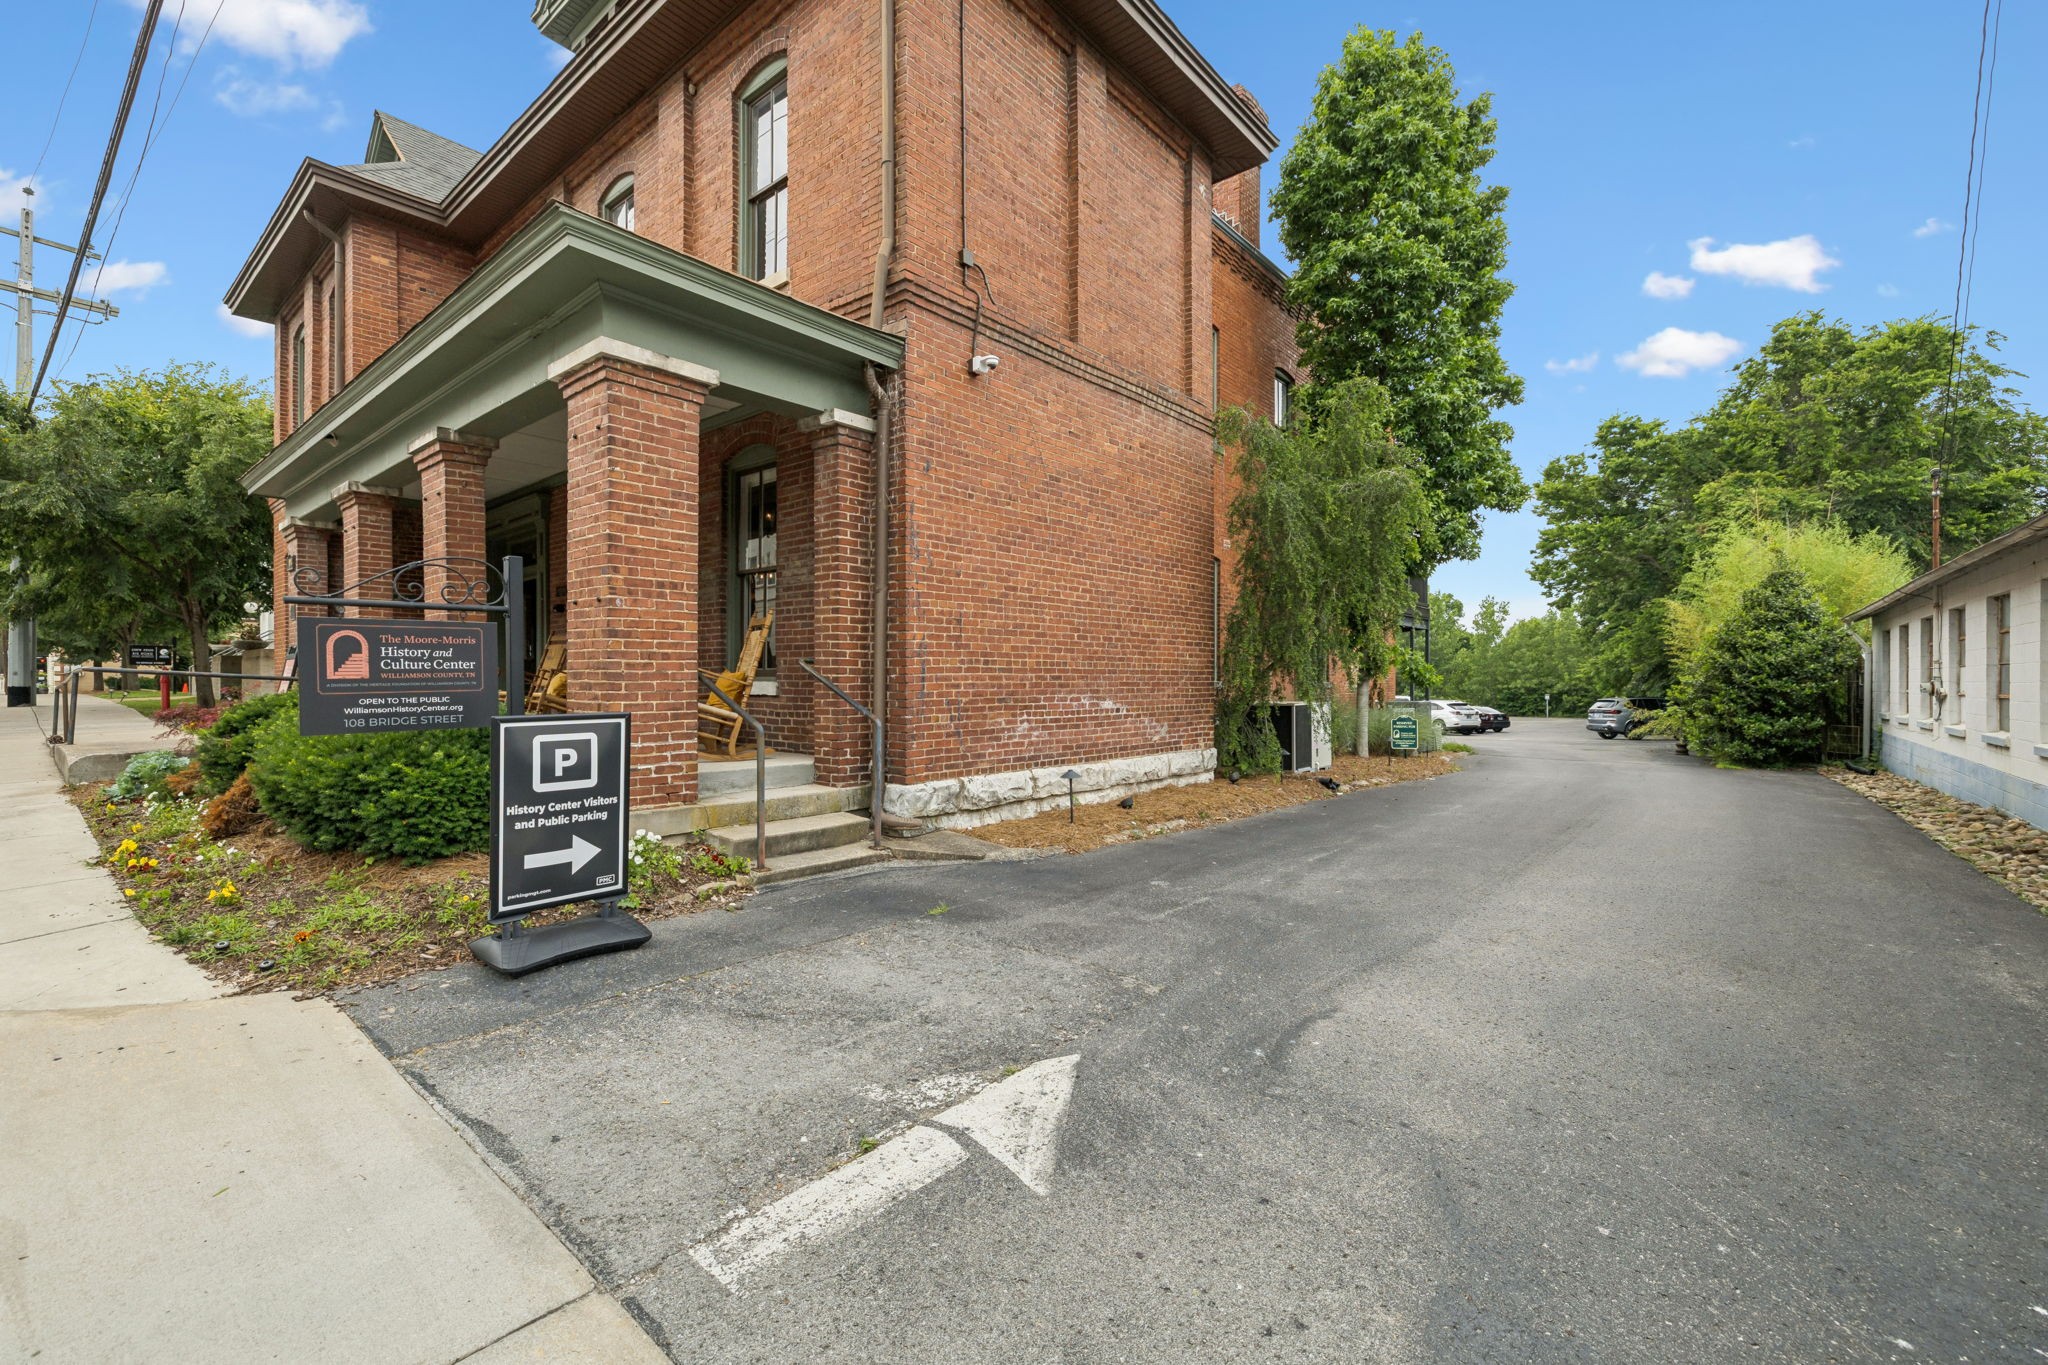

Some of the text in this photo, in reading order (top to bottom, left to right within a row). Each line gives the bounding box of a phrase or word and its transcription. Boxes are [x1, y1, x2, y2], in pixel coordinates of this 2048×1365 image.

[380, 634, 476, 645] The Moore-Morris
[380, 646, 453, 660] History and
[380, 658, 476, 670] Culture Center
[432, 671, 464, 679] COUNTY,
[343, 704, 464, 715] WilliamsonHistoryCenter.org
[343, 714, 464, 728] 108 BRIDGE STREET
[554, 747, 578, 777] P
[506, 796, 618, 816] History Center Visitors
[514, 810, 608, 830] and Public Parking
[598, 876, 613, 884] PMC
